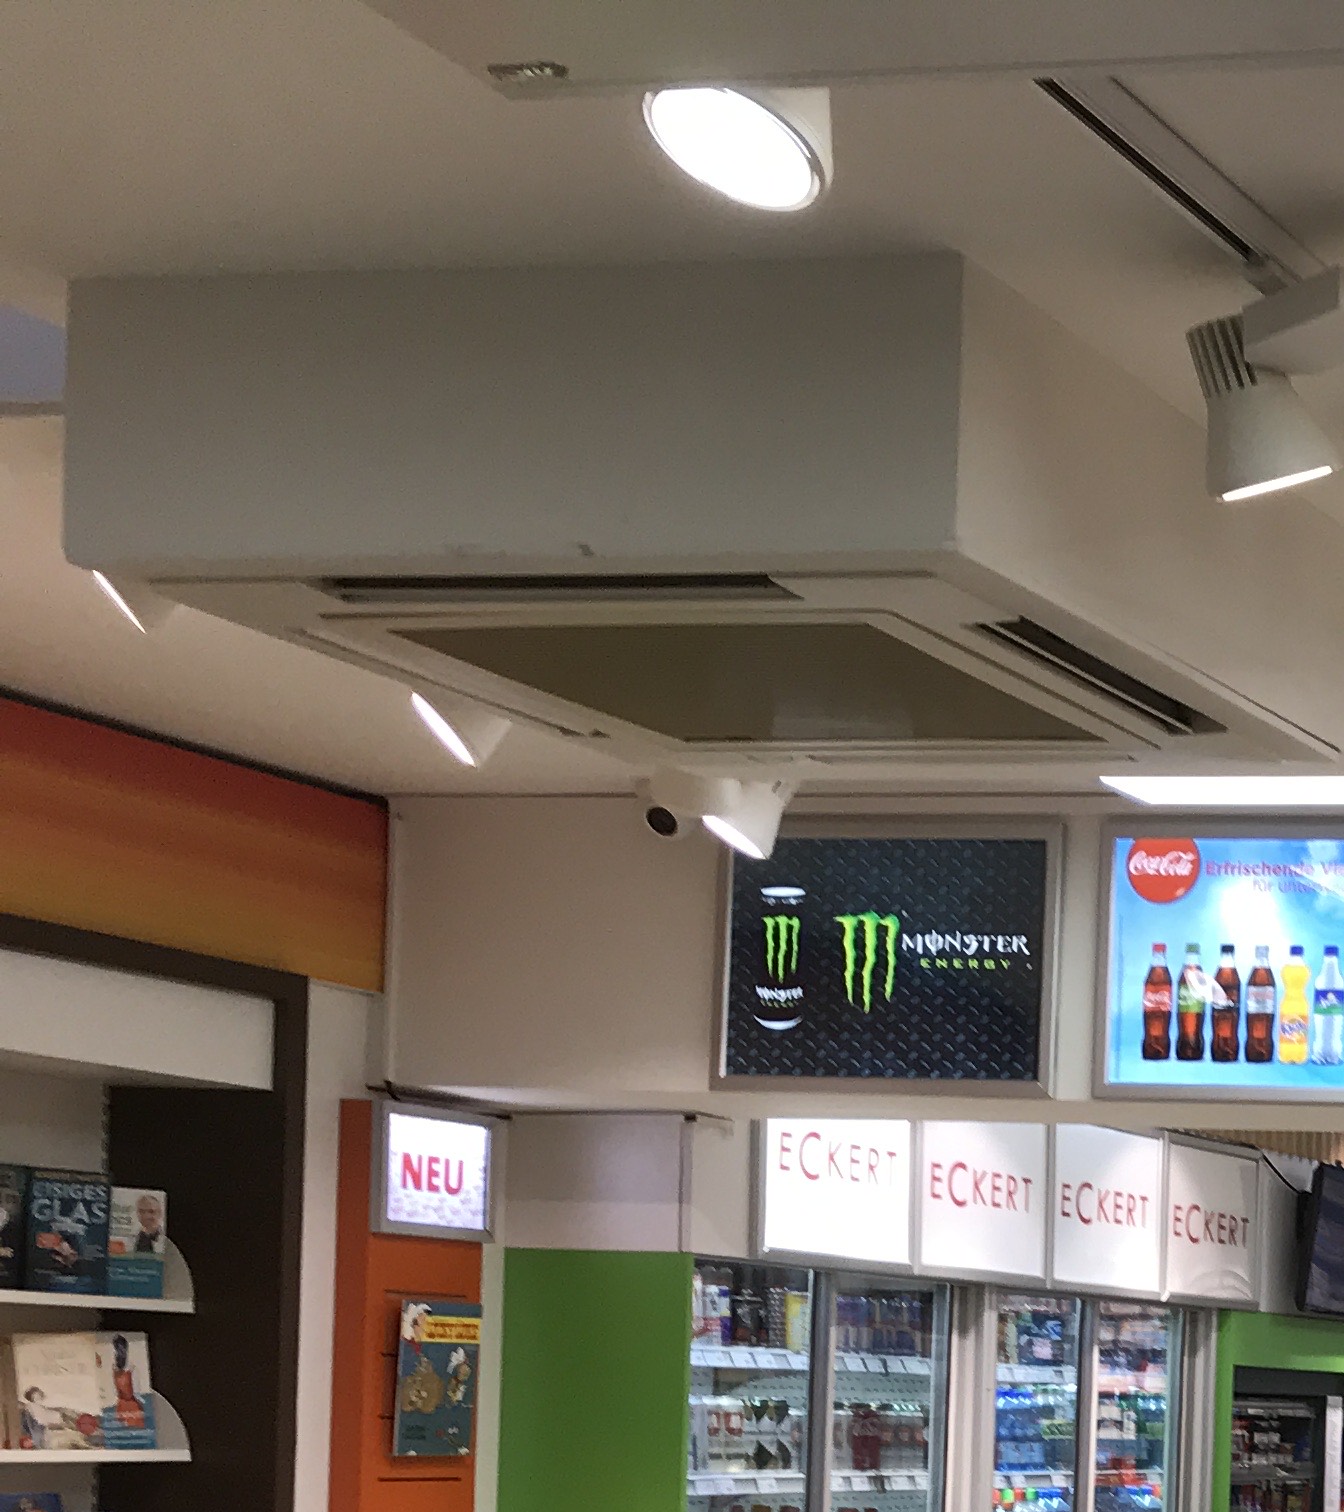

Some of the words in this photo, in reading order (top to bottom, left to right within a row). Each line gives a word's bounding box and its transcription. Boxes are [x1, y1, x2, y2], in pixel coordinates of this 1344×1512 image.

[1206, 861, 1315, 877] Erfrischende
[901, 930, 1031, 956] MONSTER
[920, 958, 1011, 970] ENERGY
[401, 1151, 464, 1196] NEU
[778, 1131, 898, 1186] ECKERT
[929, 1159, 1034, 1216] ECKERT
[1059, 1180, 1151, 1230] ECKERT
[30, 1198, 108, 1226] GLAS
[1172, 1203, 1252, 1249] ECKERT
